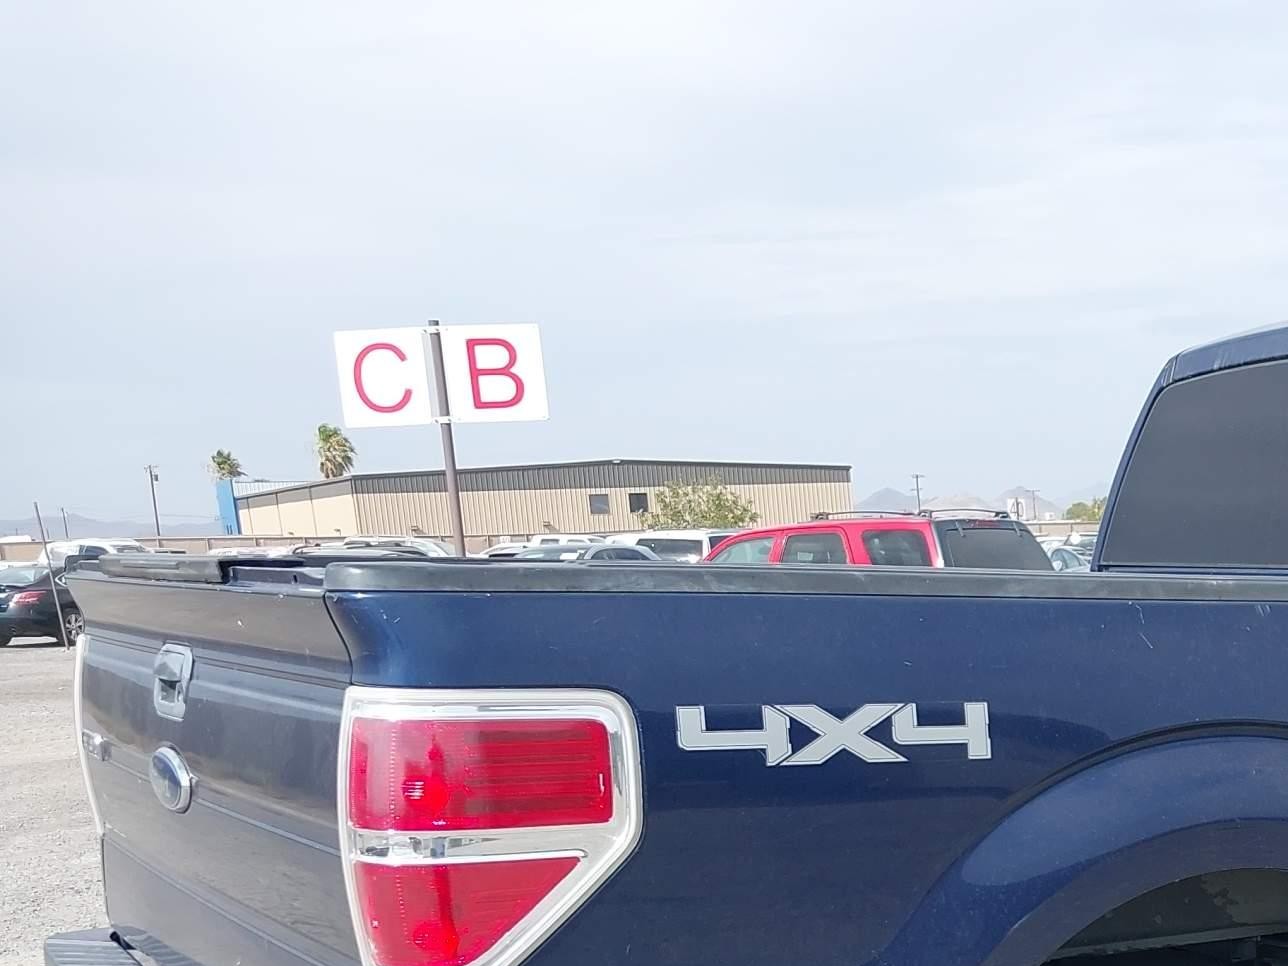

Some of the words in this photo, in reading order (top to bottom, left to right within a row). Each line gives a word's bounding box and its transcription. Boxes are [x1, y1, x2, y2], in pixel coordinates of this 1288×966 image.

[353, 342, 413, 413] C
[465, 338, 525, 409] B
[676, 702, 992, 766] 4X4
